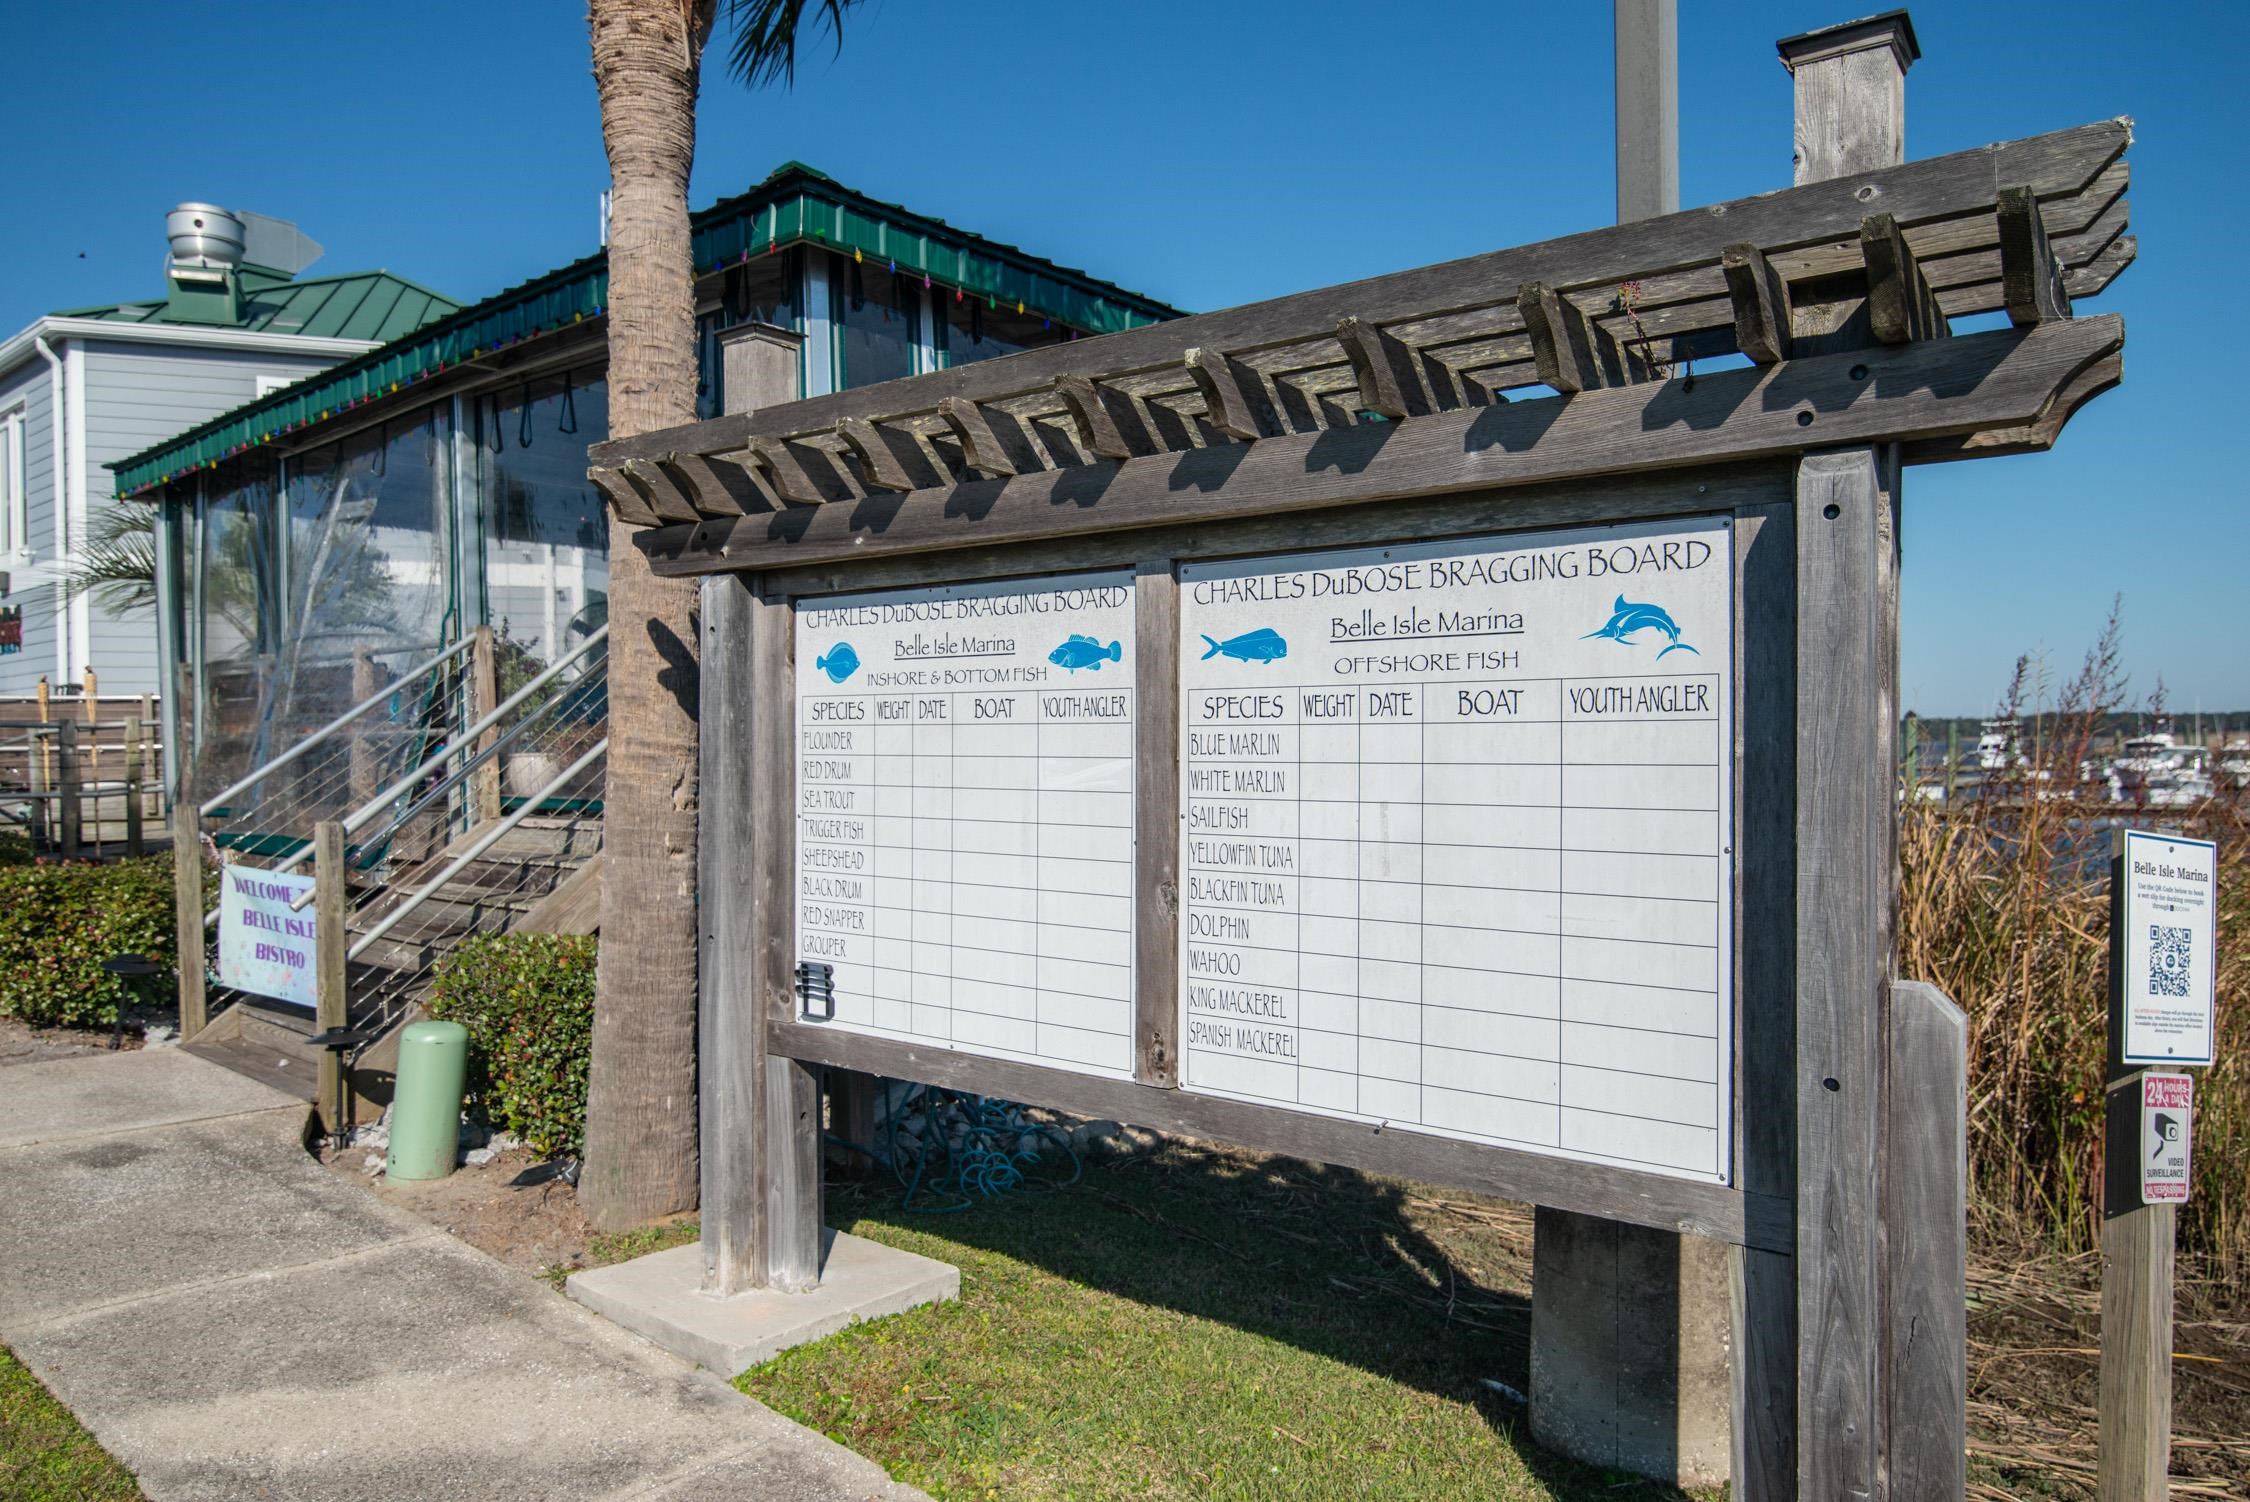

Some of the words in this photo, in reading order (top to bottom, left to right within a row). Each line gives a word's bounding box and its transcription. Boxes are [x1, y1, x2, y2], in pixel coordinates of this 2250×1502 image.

[1194, 572, 1305, 605] CHARLES
[1313, 564, 1422, 597] DuBOSE
[1429, 551, 1579, 589] BRAGGING
[1587, 540, 1712, 577] BOARD
[806, 604, 879, 629] CHARLES
[883, 600, 953, 624] DuBOSE
[957, 592, 1049, 619] BRAGGING
[1053, 585, 1128, 611] BOARD
[1331, 607, 1386, 639] Belle
[1393, 605, 1432, 635] Isle
[1439, 606, 1524, 632] Marina
[895, 633, 930, 657] Belle
[934, 632, 957, 655] Isle
[962, 634, 1015, 653] Marina
[1334, 652, 1460, 675] OFFSHORE
[1467, 650, 1519, 671] FISH
[867, 671, 928, 687] INSHORE
[931, 671, 941, 685] &
[944, 668, 1010, 685] BOTTOM
[1013, 666, 1047, 682] FISH
[812, 701, 865, 720] SPECIES
[877, 700, 910, 720] WEIGHT
[919, 700, 947, 719] DATE
[974, 698, 1015, 719] BOAT
[1042, 697, 1081, 718] YOUTH
[1082, 696, 1127, 718] ANGLER
[1203, 694, 1284, 719] SPECIES
[1303, 693, 1356, 718] WEIGHT
[1369, 692, 1414, 717] DATE
[1458, 689, 1524, 716] BOAT
[1570, 687, 1635, 715] YOUTH
[1637, 684, 1710, 714] ANGLER
[803, 731, 852, 750] FLOUNDER
[1190, 733, 1226, 756] BLUE
[1230, 733, 1280, 756] MARLIN
[803, 760, 823, 779] RED
[824, 761, 851, 780] DRUM
[1190, 769, 1231, 792] WHITE
[1234, 770, 1285, 793] MARLIN
[803, 789, 821, 808] SEA
[823, 790, 855, 810] TROUT
[803, 819, 842, 839] TRIGGER
[843, 820, 864, 840] FISH
[1190, 805, 1249, 830] SAILFISH
[803, 848, 865, 870] SHEEPSHEAD
[1190, 842, 1256, 867] YELLOWFIN
[1259, 845, 1294, 869] TUNA
[2134, 861, 2157, 876] Belle
[2159, 864, 2175, 878] Isle
[2177, 867, 2208, 882] Marina
[234, 877, 294, 904] WELCOME
[803, 876, 832, 897] BLACK
[835, 878, 862, 900] DRUM
[1190, 877, 1248, 903] BLACKFIN
[1251, 881, 1285, 906] TUNA
[243, 909, 282, 933] BELLE
[285, 917, 316, 941] ISLE
[803, 905, 821, 925] RED
[824, 908, 865, 931] SNAPPER
[1190, 913, 1250, 940] DOLPHIN
[255, 942, 305, 969] BISTRO
[803, 935, 847, 958] GROUPER
[1189, 950, 1241, 976] WAHOO
[1189, 985, 1217, 1011] KING
[1219, 990, 1288, 1020] MACKEREL
[1189, 1021, 1232, 1049] SPANISH
[1236, 1028, 1297, 1059] MACKEREL
[2147, 1082, 2163, 1104] 24
[2147, 1168, 2184, 1178] SURVEILLANCE
[2168, 1157, 2184, 1167] VIDEO
